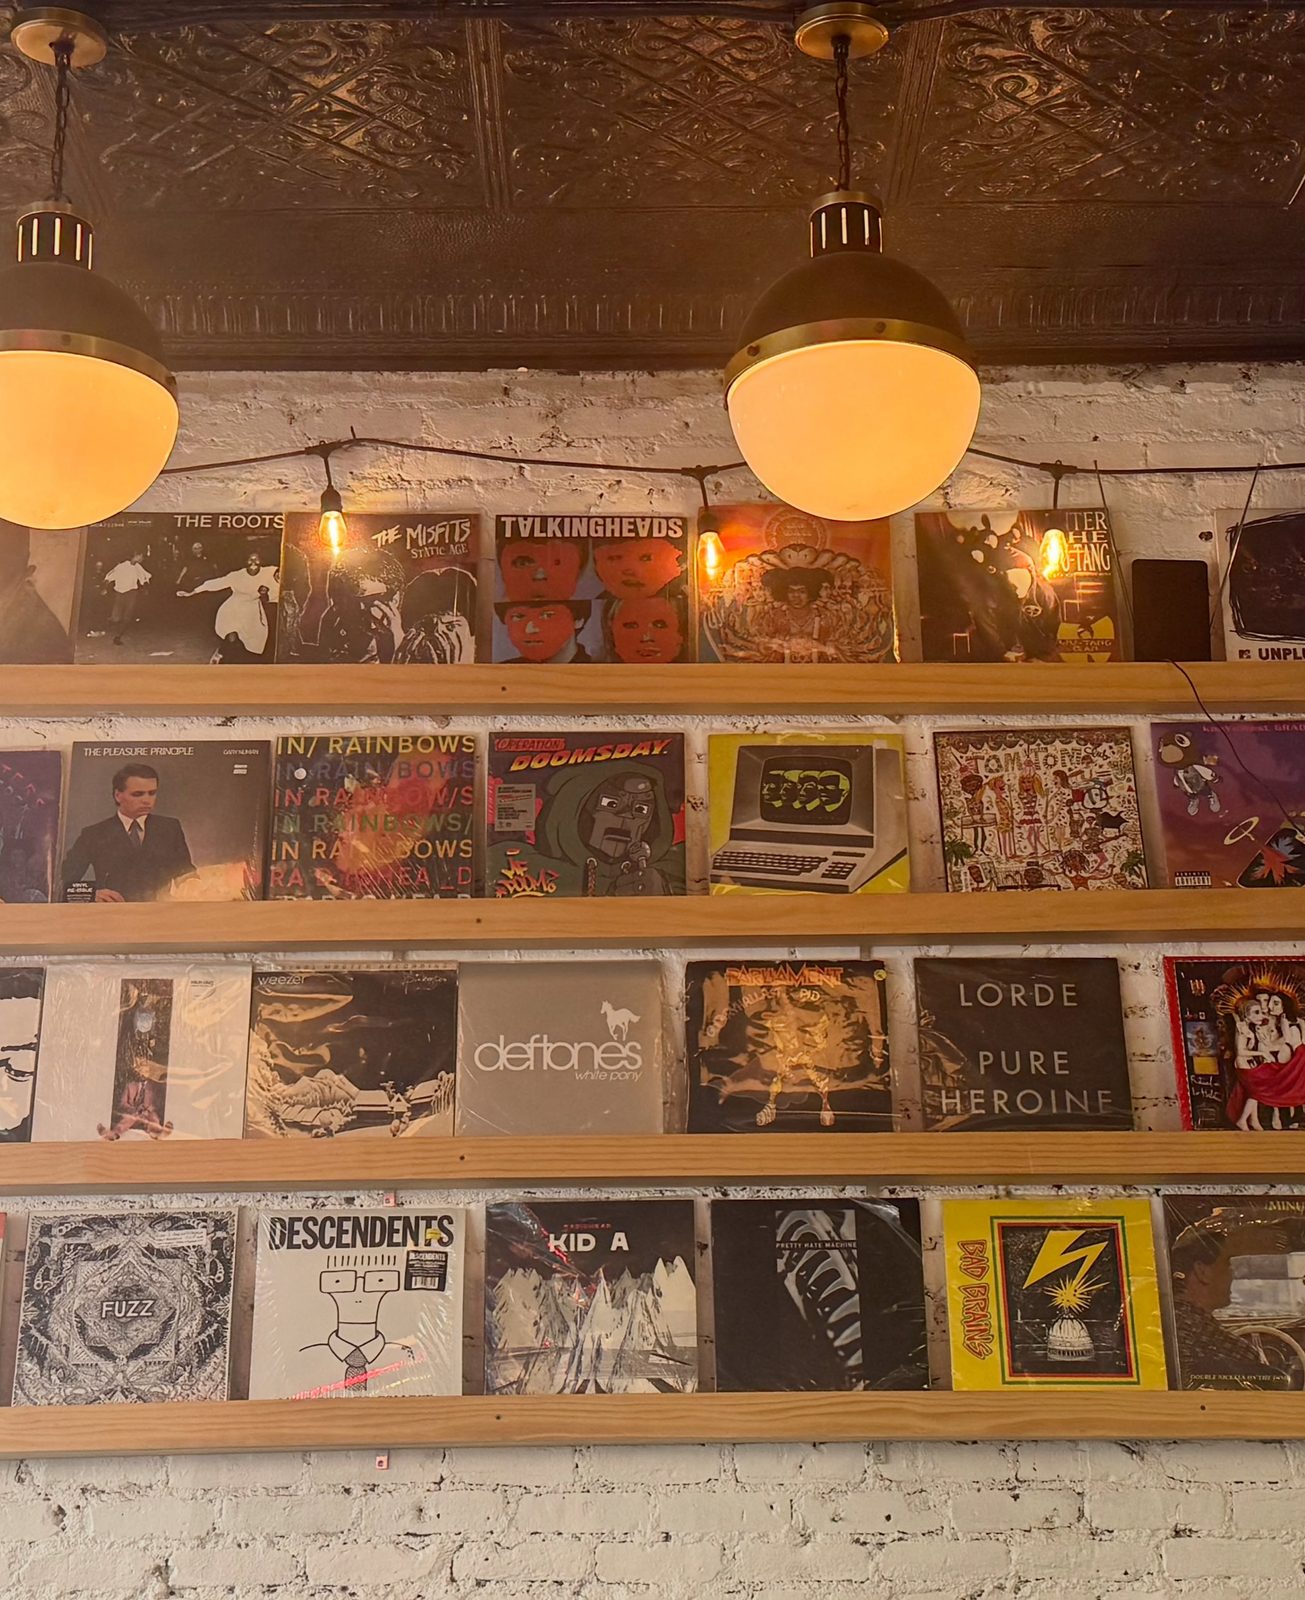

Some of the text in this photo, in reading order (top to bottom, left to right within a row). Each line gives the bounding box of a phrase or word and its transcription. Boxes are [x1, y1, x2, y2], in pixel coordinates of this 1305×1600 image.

[174, 514, 285, 529] THE ROOTS
[371, 518, 471, 550] THE MISFITS
[1069, 531, 1108, 544] HE
[411, 543, 468, 559] STATIC AGE
[1062, 543, 1111, 572] U-TANG
[84, 746, 195, 757] THE PLEASURE PRINCIPLE
[277, 736, 475, 758] IN/ RAINBOWS
[497, 737, 562, 751] OPERATION
[274, 789, 303, 808] IN
[273, 815, 301, 833] IN
[271, 839, 473, 861] IN RABOWS
[258, 974, 306, 986] weezer
[726, 962, 844, 988] PARLIAMENT
[959, 982, 1079, 1007] LORDE
[474, 1034, 642, 1072] deftones
[978, 1050, 1071, 1075] PURE
[574, 1070, 643, 1082] white pony
[940, 1088, 1114, 1114] HEROINE
[269, 1214, 455, 1250] DESCENDENTS
[548, 1232, 630, 1252] KID A
[825, 1241, 857, 1249] MACHINE
[957, 1239, 990, 1281] BAD
[101, 1299, 156, 1319] FUZZ
[958, 1282, 995, 1360] BRAINS
